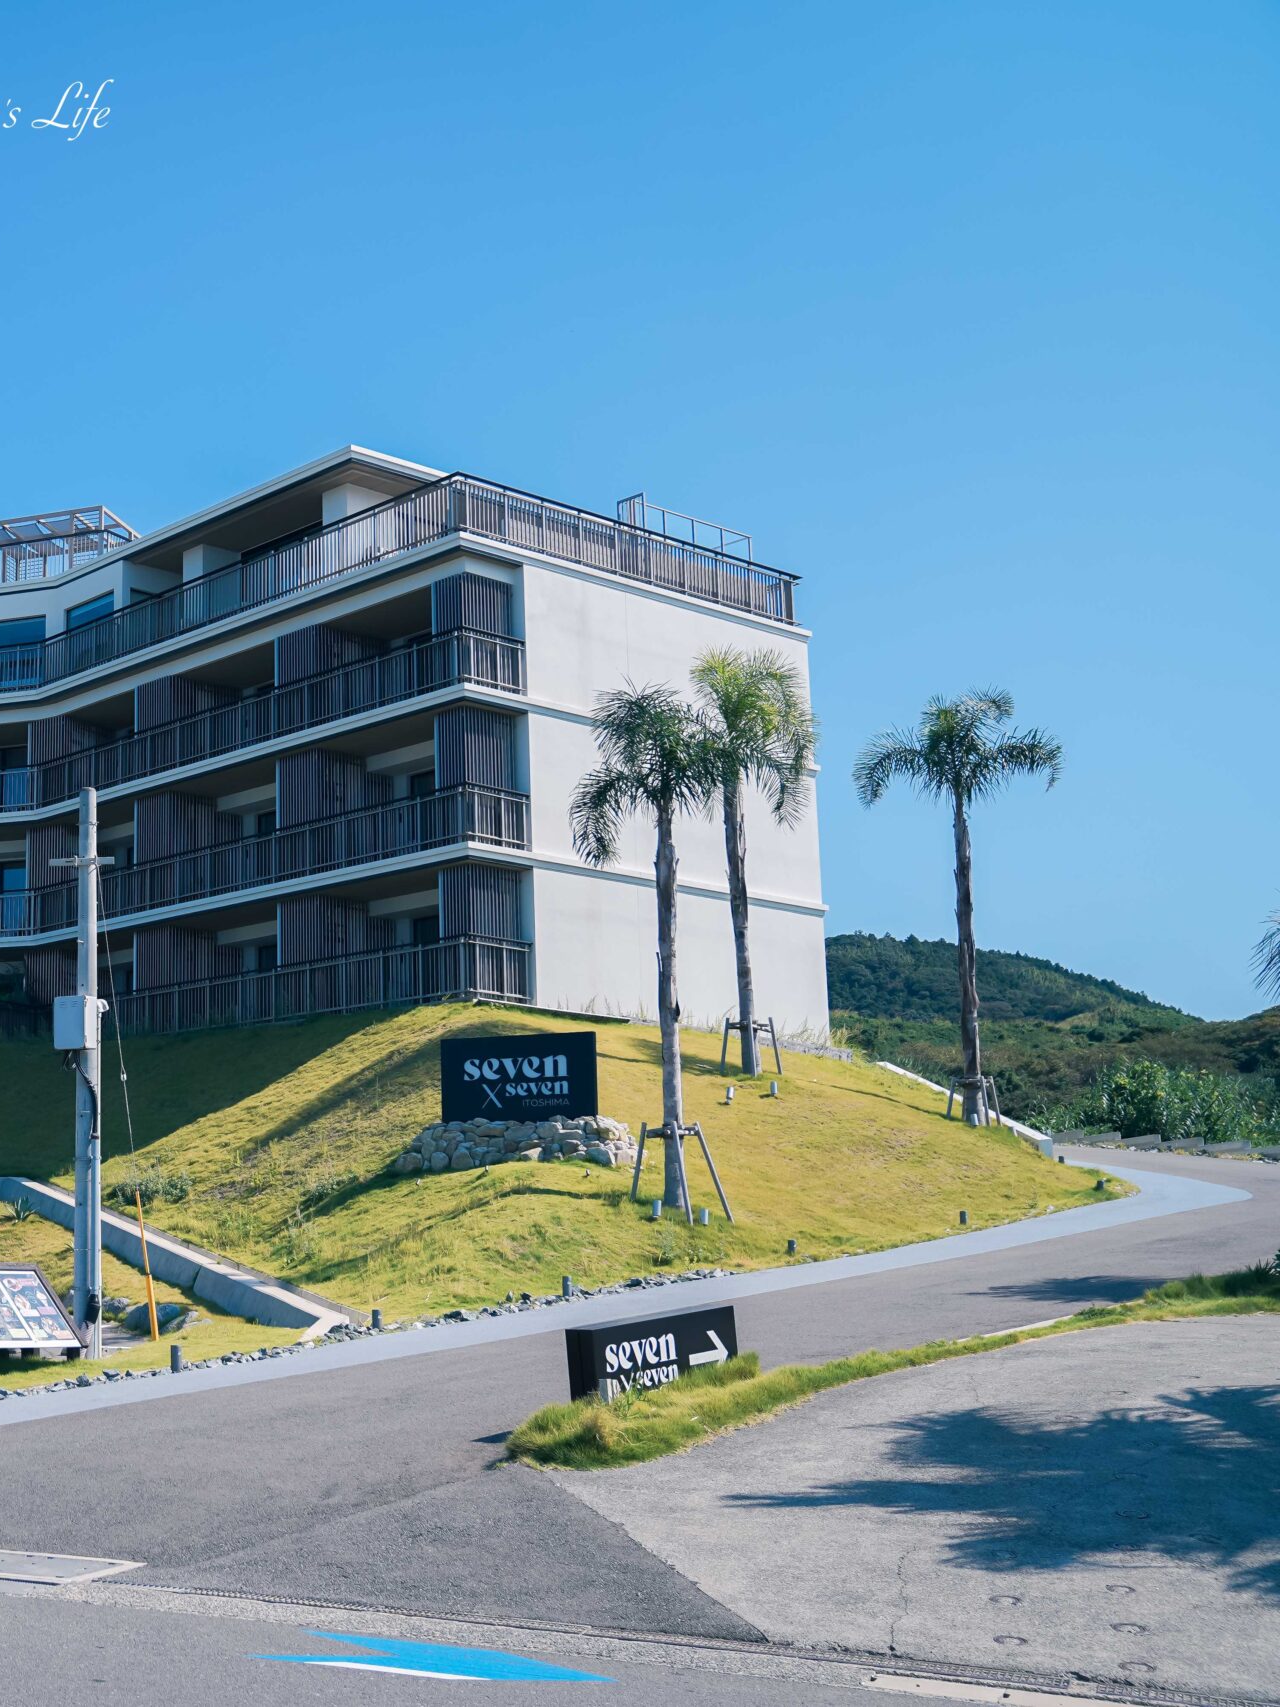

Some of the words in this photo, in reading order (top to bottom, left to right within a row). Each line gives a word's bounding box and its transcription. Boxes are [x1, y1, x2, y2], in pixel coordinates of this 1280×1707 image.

[463, 1054, 569, 1081] seven
[505, 1080, 570, 1097] seven
[522, 1097, 570, 1108] ITOSHIMA
[605, 1332, 678, 1373] seven
